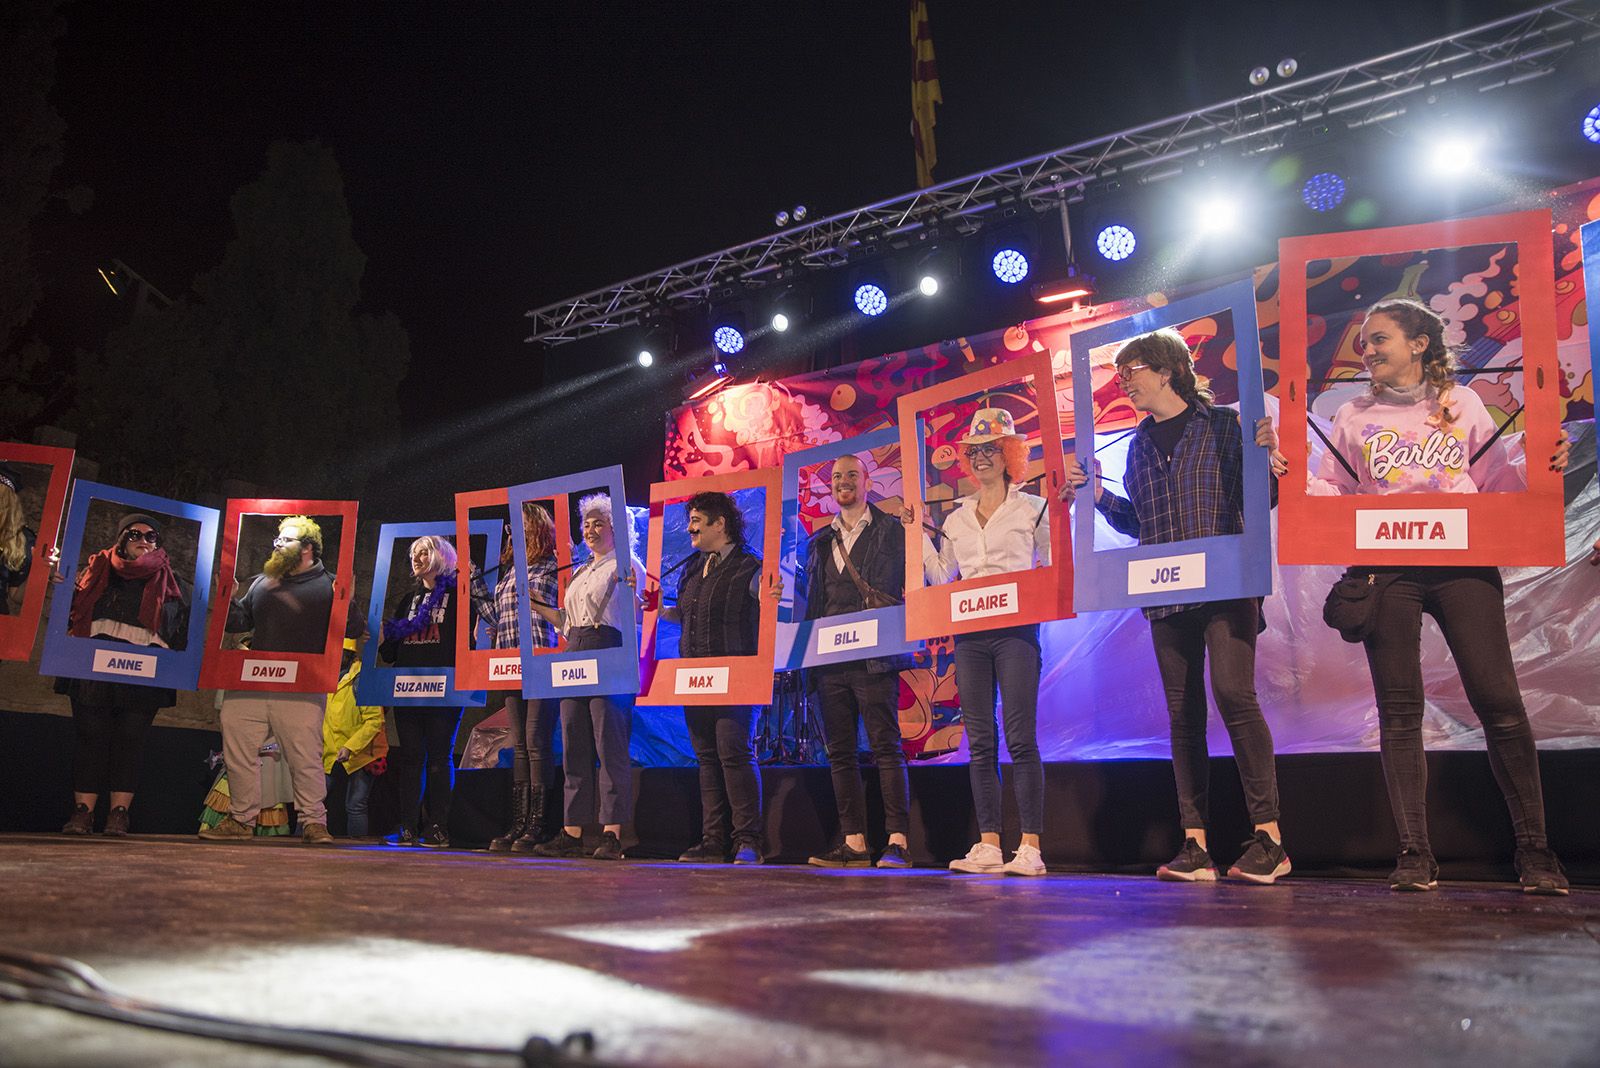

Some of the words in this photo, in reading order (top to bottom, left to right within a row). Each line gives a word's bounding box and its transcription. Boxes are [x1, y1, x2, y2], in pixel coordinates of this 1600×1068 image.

[1365, 429, 1464, 480] Barbie
[1375, 521, 1446, 540] ANITA
[1150, 566, 1181, 585] JOE
[959, 593, 1008, 614] CLAIRE
[833, 630, 860, 646] BILL
[107, 658, 143, 671] ANNE
[493, 664, 522, 676] ALFRE
[251, 666, 287, 678] DAVID
[561, 668, 587, 680] PAUL
[395, 681, 444, 693] SUZANNE
[688, 675, 714, 688] MAX
